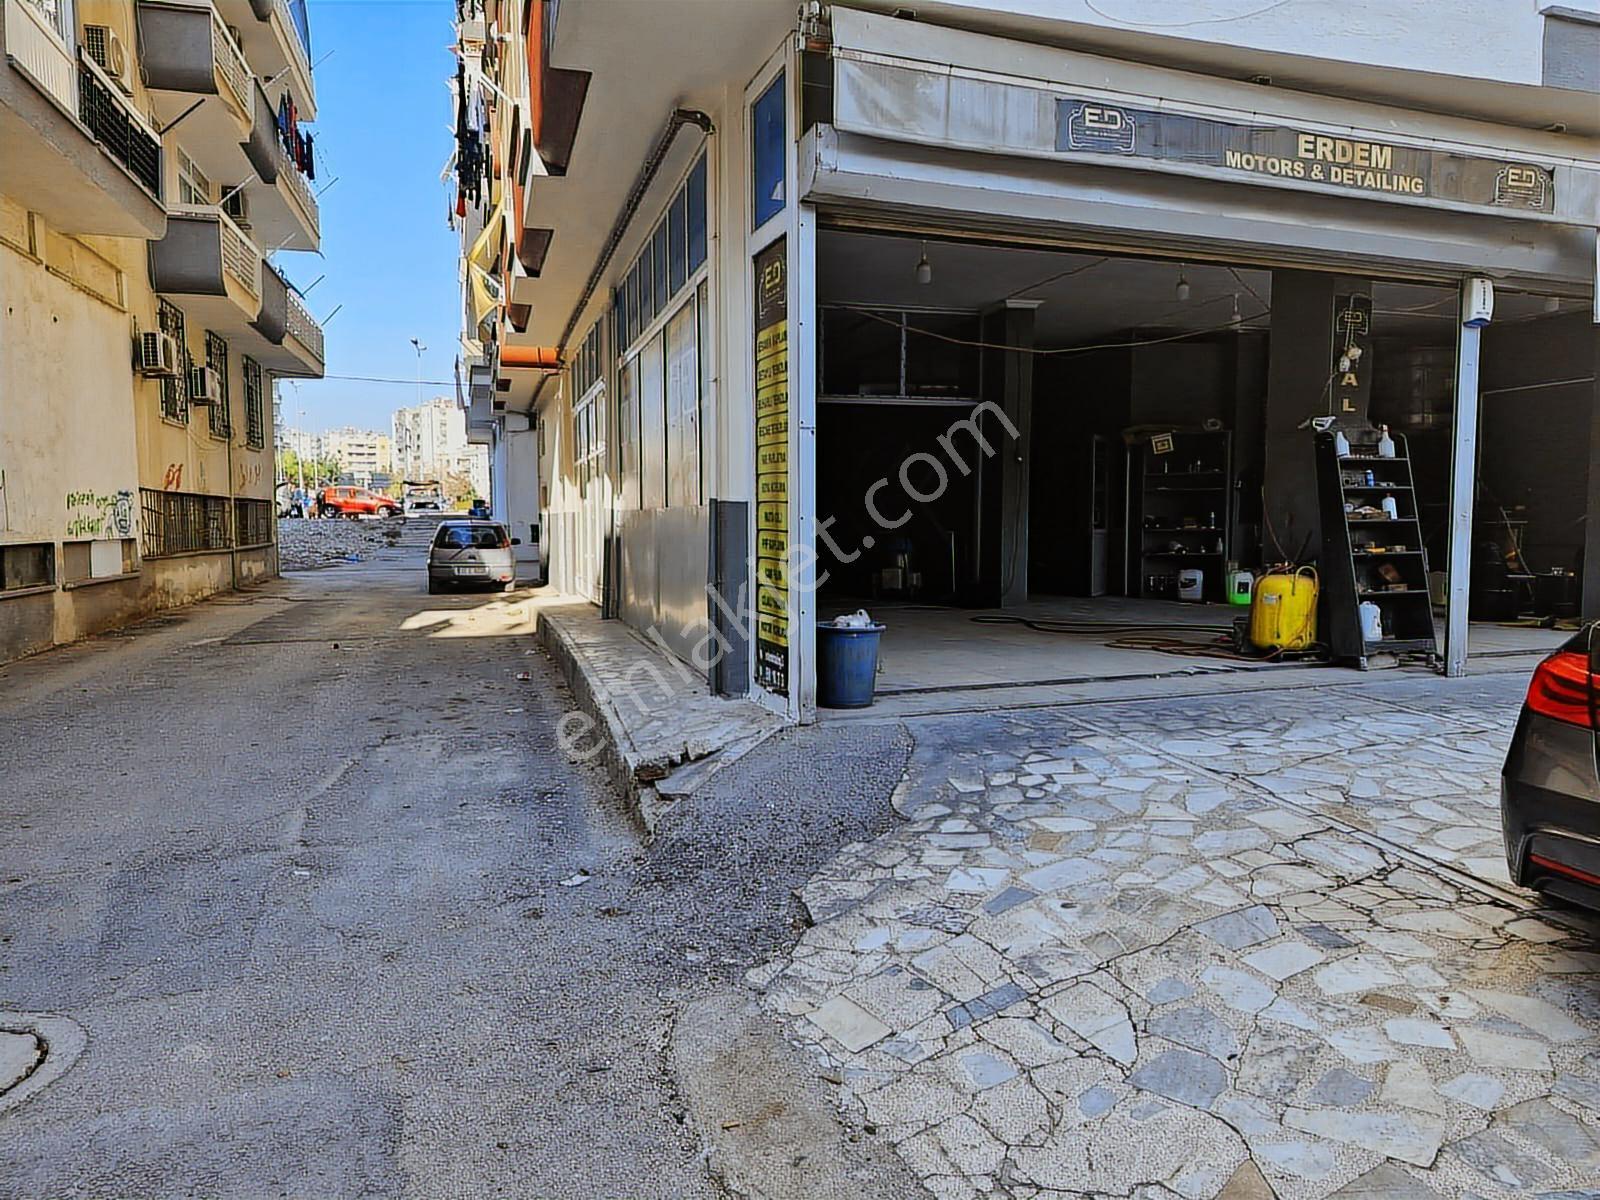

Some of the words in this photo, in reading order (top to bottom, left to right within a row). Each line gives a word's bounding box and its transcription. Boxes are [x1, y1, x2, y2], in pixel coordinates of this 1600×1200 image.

[1225, 150, 1305, 178] MOTORS
[1310, 163, 1325, 180] &
[1330, 166, 1424, 194] DETAILING
[1297, 134, 1392, 170] ERDEM
